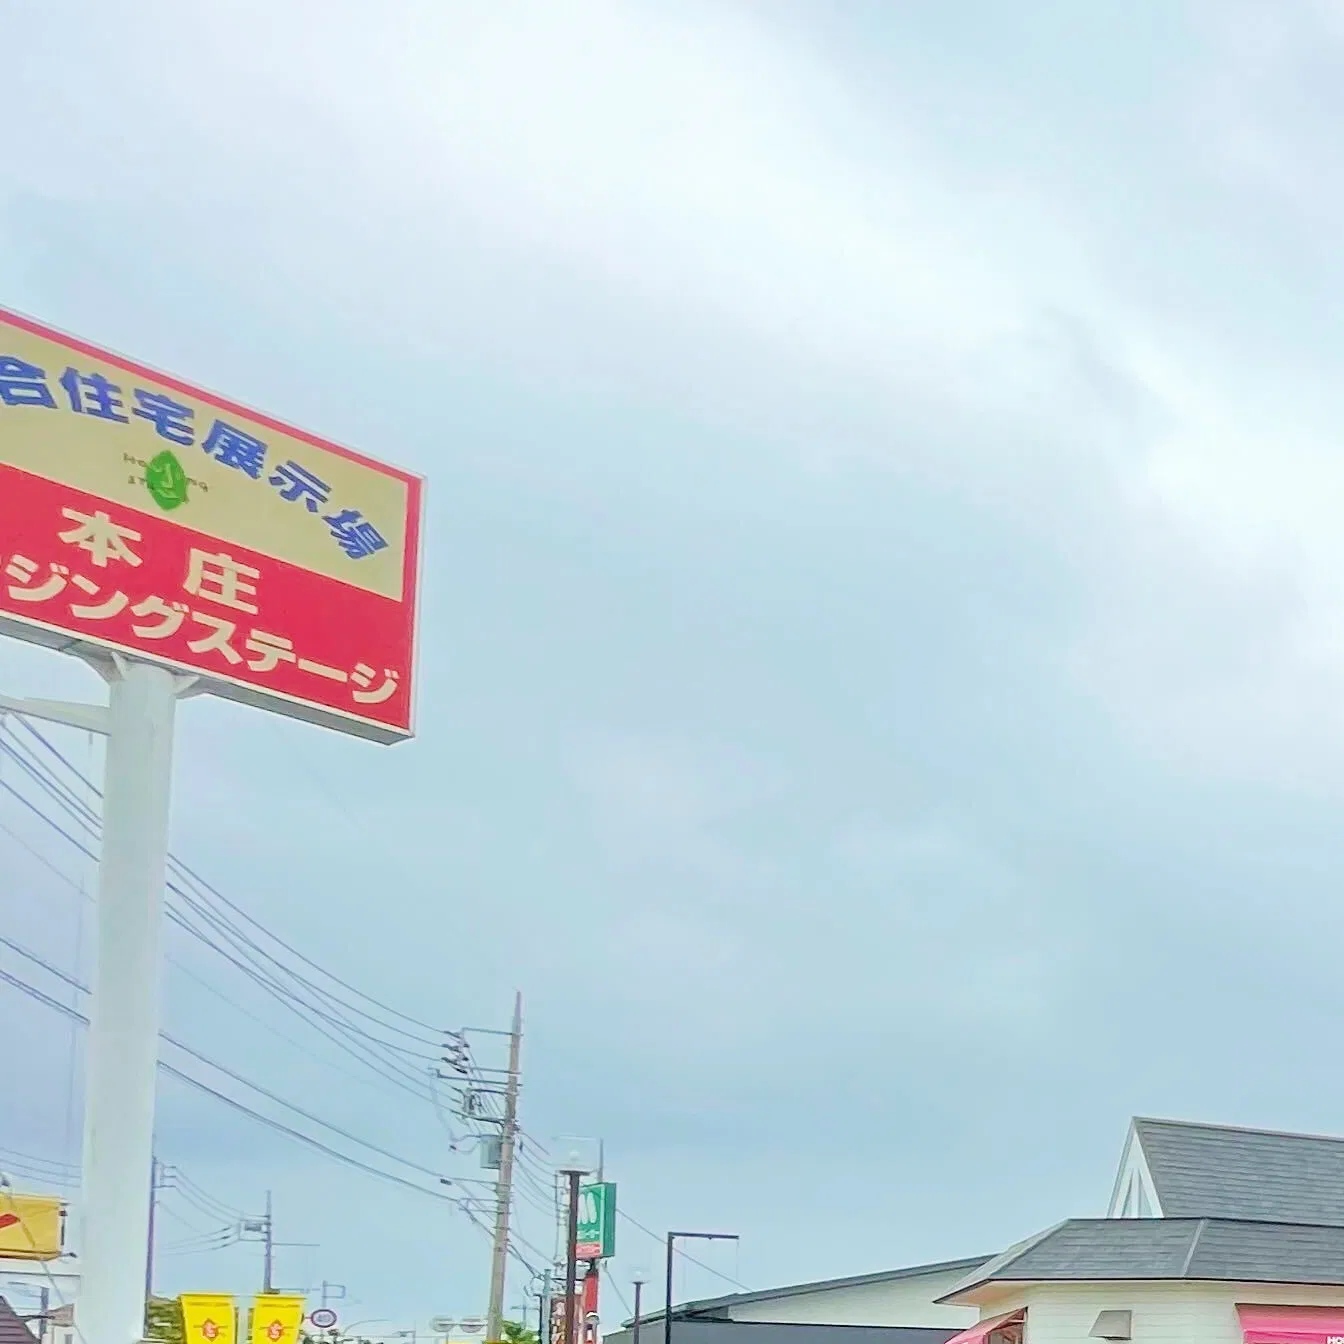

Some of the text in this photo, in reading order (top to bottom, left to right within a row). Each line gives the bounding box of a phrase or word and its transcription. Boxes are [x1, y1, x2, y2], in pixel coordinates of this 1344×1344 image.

[58, 506, 260, 615] 本庄
[0, 553, 399, 704] ジングステージ
